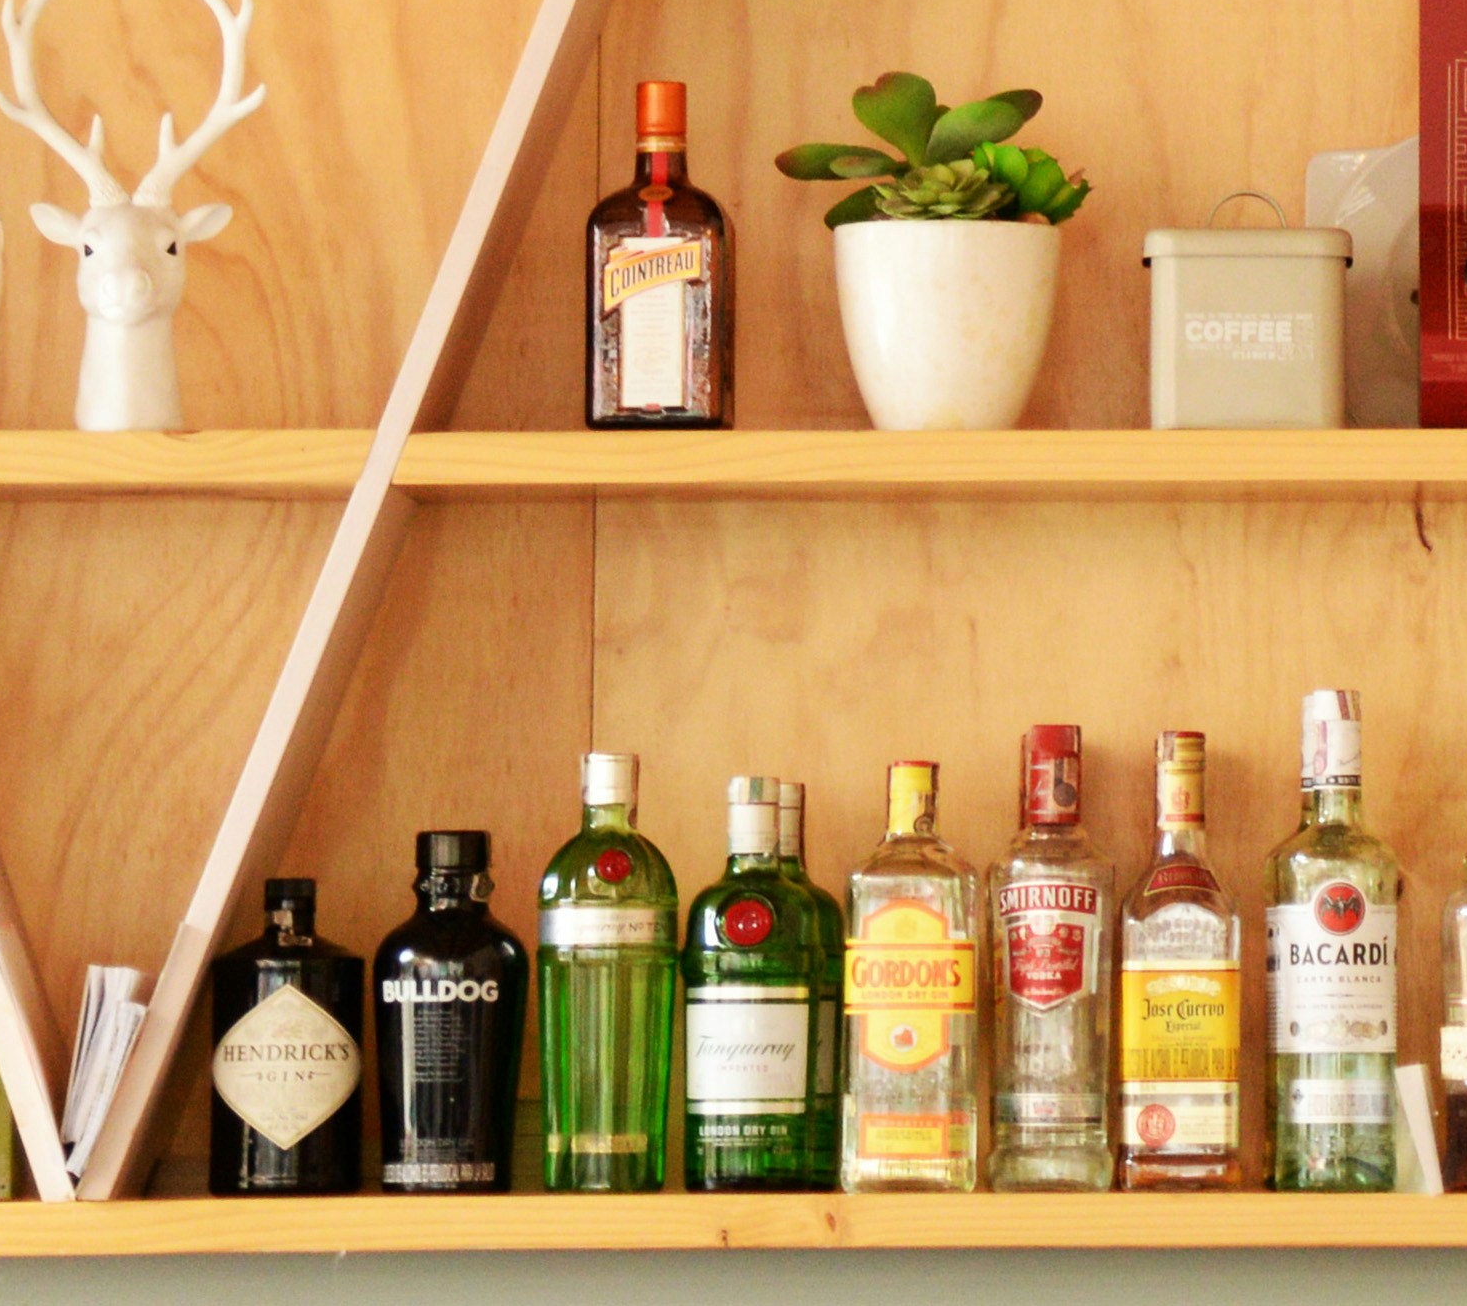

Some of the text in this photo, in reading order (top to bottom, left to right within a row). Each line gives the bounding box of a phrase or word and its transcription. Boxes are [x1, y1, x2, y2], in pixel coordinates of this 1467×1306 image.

[609, 249, 696, 299] COINTREAU
[1185, 319, 1294, 343] COFFEE
[999, 886, 1094, 913] SMIRNOFF
[1290, 936, 1389, 966] BACARDÍ
[851, 956, 962, 988] GORDON'S
[1026, 971, 1062, 980] VODKA
[1338, 975, 1383, 984] BLANCA
[382, 979, 499, 1003] BULLDOG
[861, 991, 950, 1000] LONDON DRY GIN
[1142, 998, 1225, 1021] Jose Cuervo
[1165, 1019, 1202, 1034] Especial
[223, 1041, 350, 1064] HENDRICK'S
[696, 1034, 796, 1062] Tanqueray
[266, 1069, 306, 1081] GIN
[698, 1125, 741, 1136] LONDON
[743, 1125, 766, 1136] DRY
